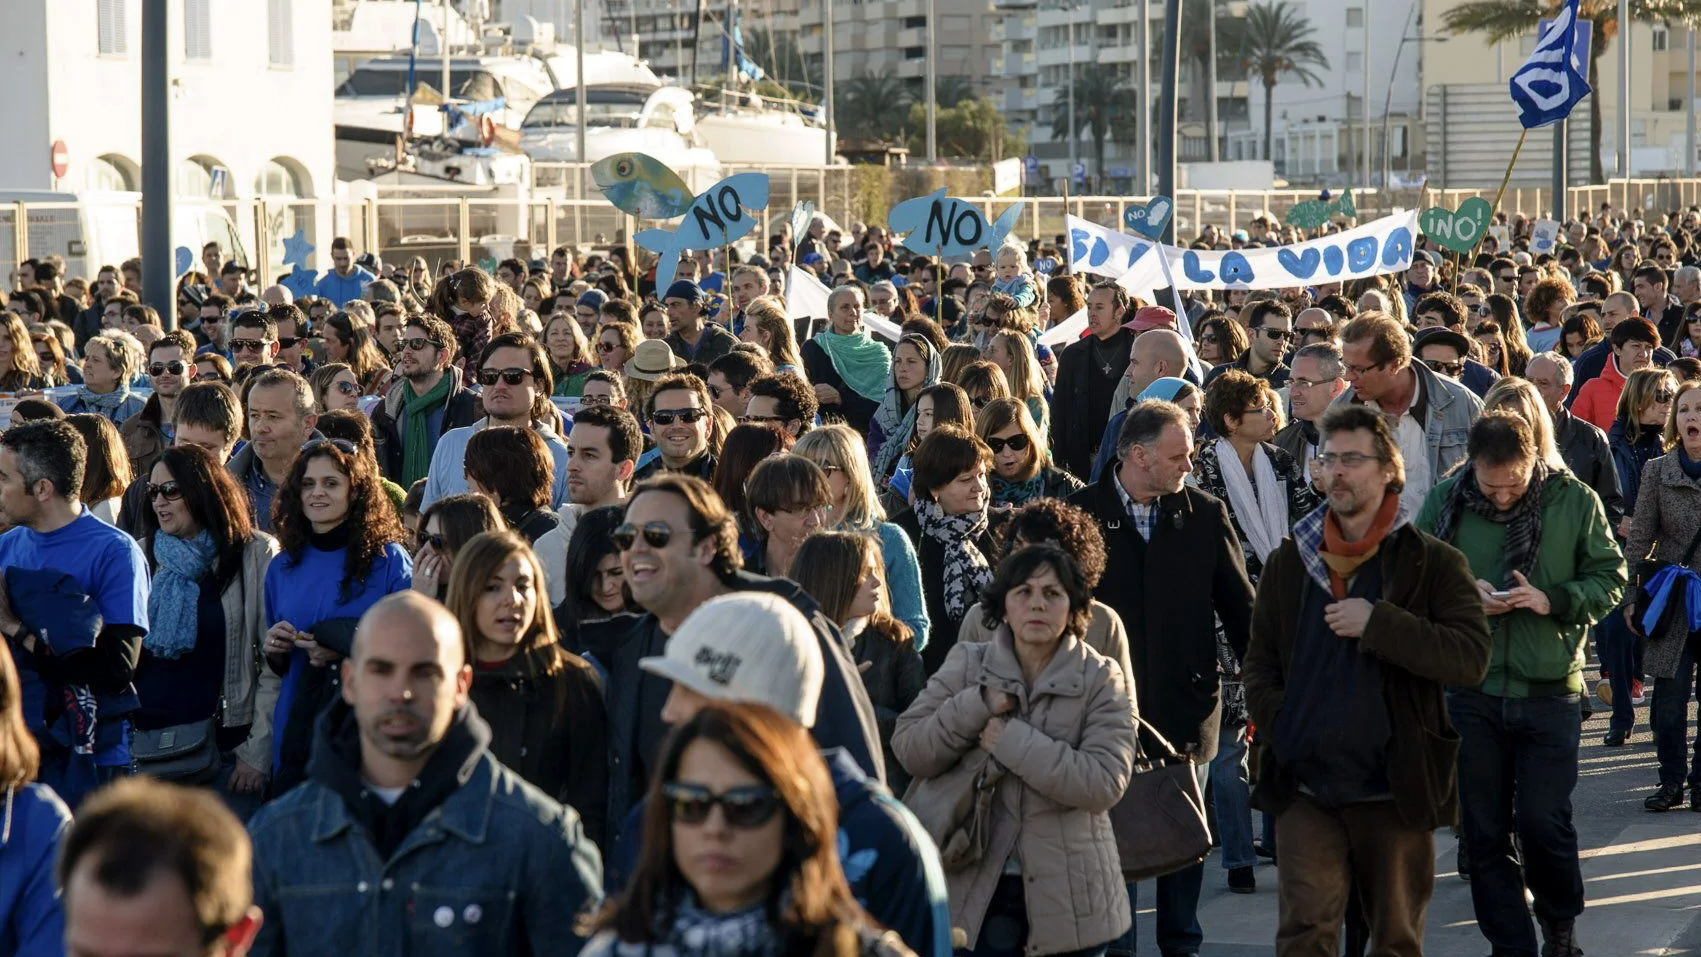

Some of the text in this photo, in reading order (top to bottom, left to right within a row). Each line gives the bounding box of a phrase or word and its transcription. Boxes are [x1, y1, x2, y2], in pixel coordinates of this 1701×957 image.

[693, 185, 742, 240] NO
[925, 199, 982, 246] NO
[1127, 209, 1146, 222] NO
[1039, 259, 1052, 271] NO
[1183, 250, 1255, 284] LA
[1278, 226, 1412, 279] VIDA
